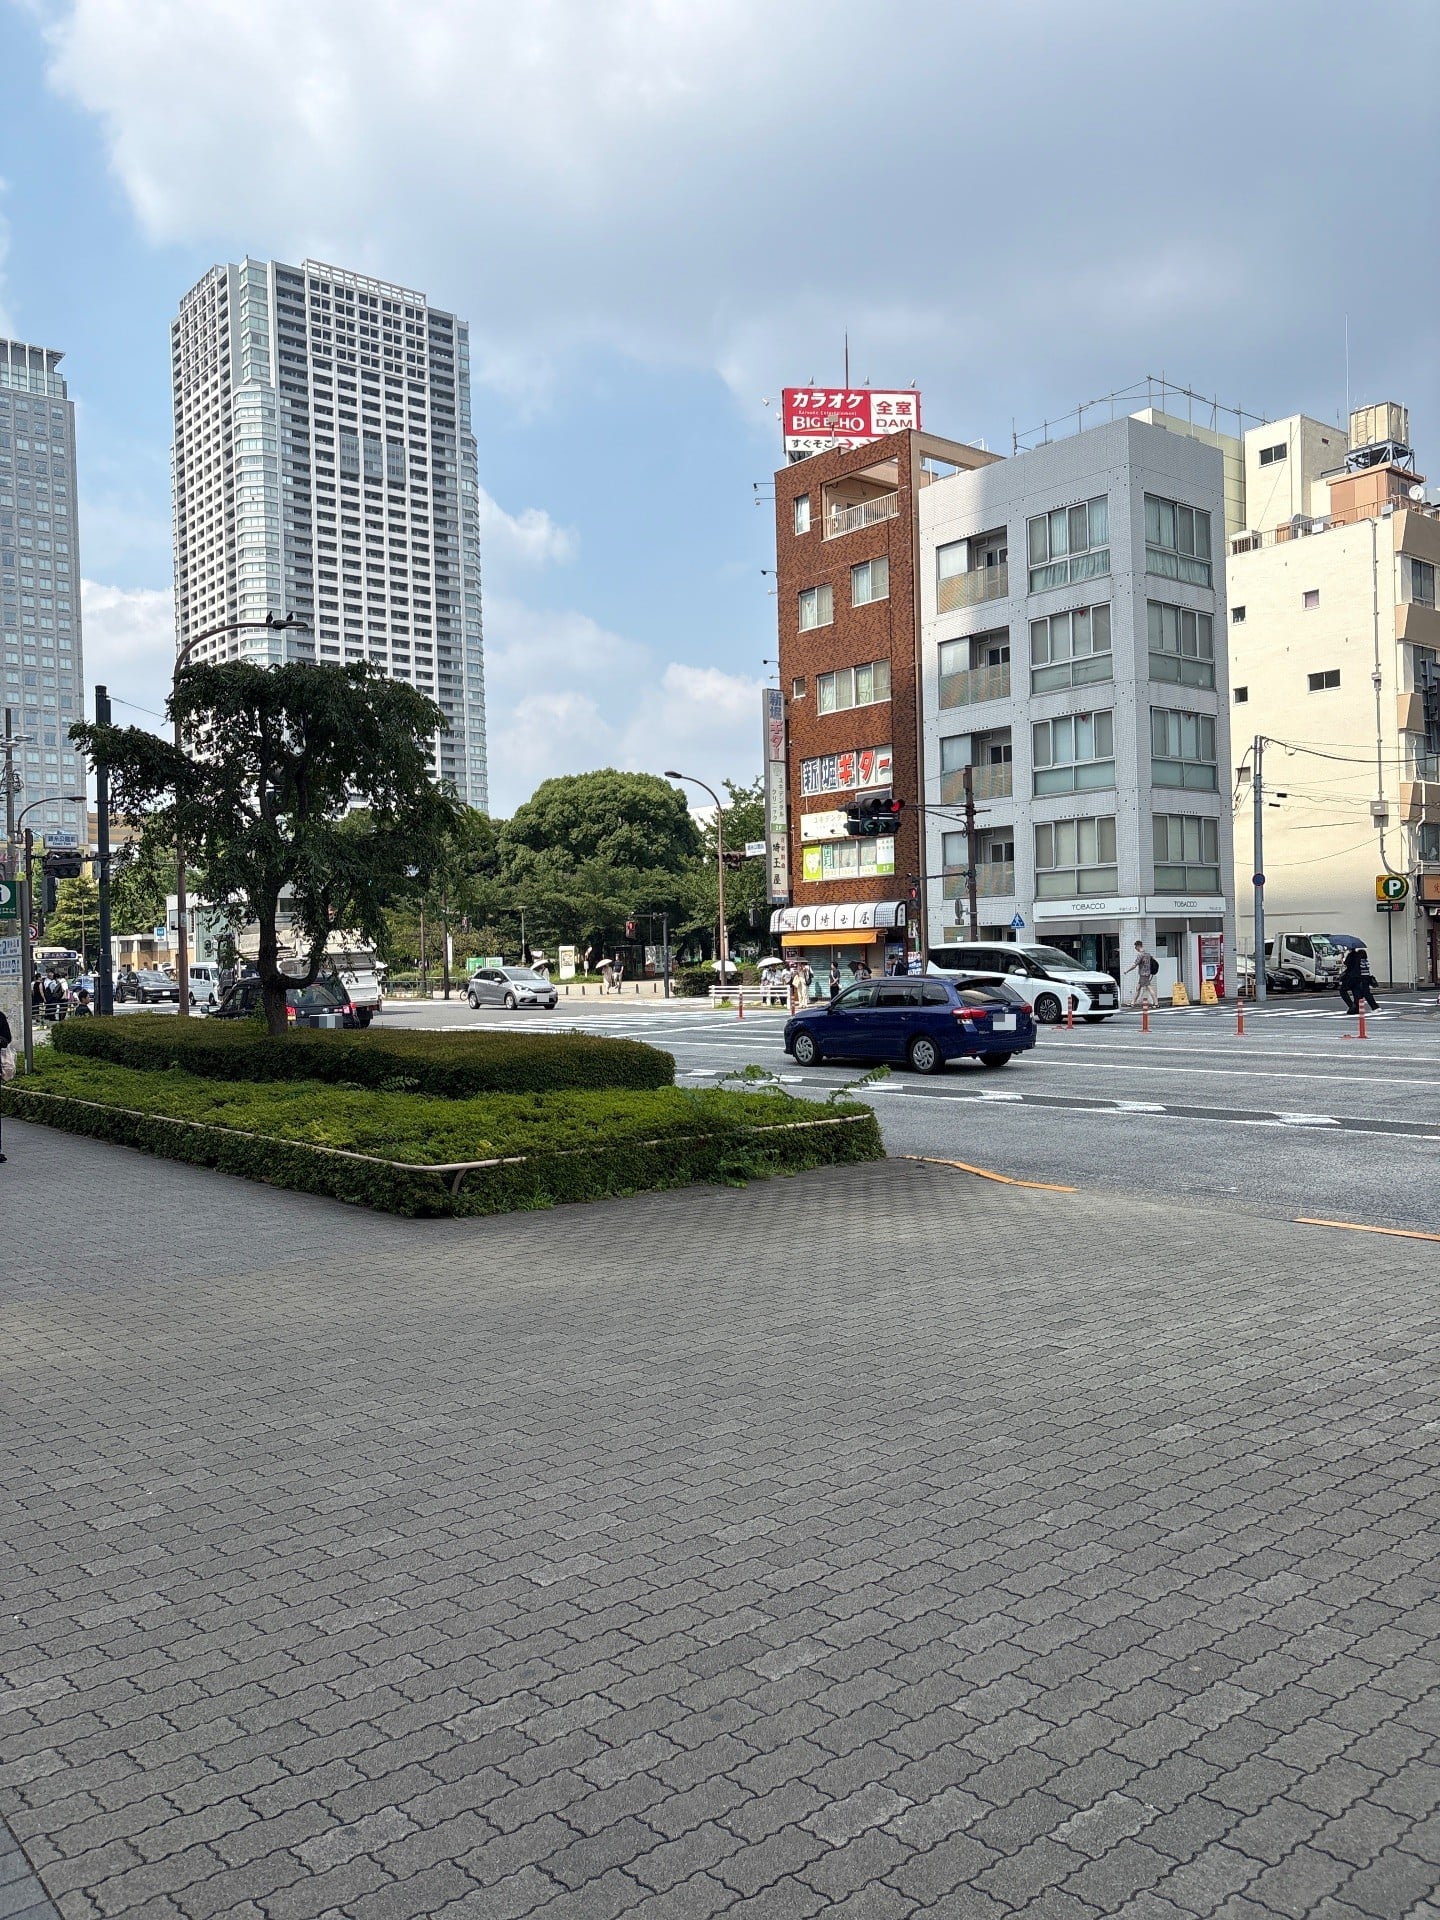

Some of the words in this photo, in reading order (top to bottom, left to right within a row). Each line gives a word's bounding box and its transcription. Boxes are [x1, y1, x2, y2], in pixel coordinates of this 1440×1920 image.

[792, 392, 864, 409] カラオケ
[876, 401, 912, 416] 全室
[792, 415, 821, 431] BIG
[876, 418, 913, 428] DAM
[791, 439, 832, 449] すぐそこ
[769, 691, 784, 760] 新堀ギター
[803, 750, 891, 792] 新堀ギター
[1388, 879, 1401, 896] P
[1071, 902, 1106, 911] TOBACCO
[1173, 900, 1198, 908] TOBACCO
